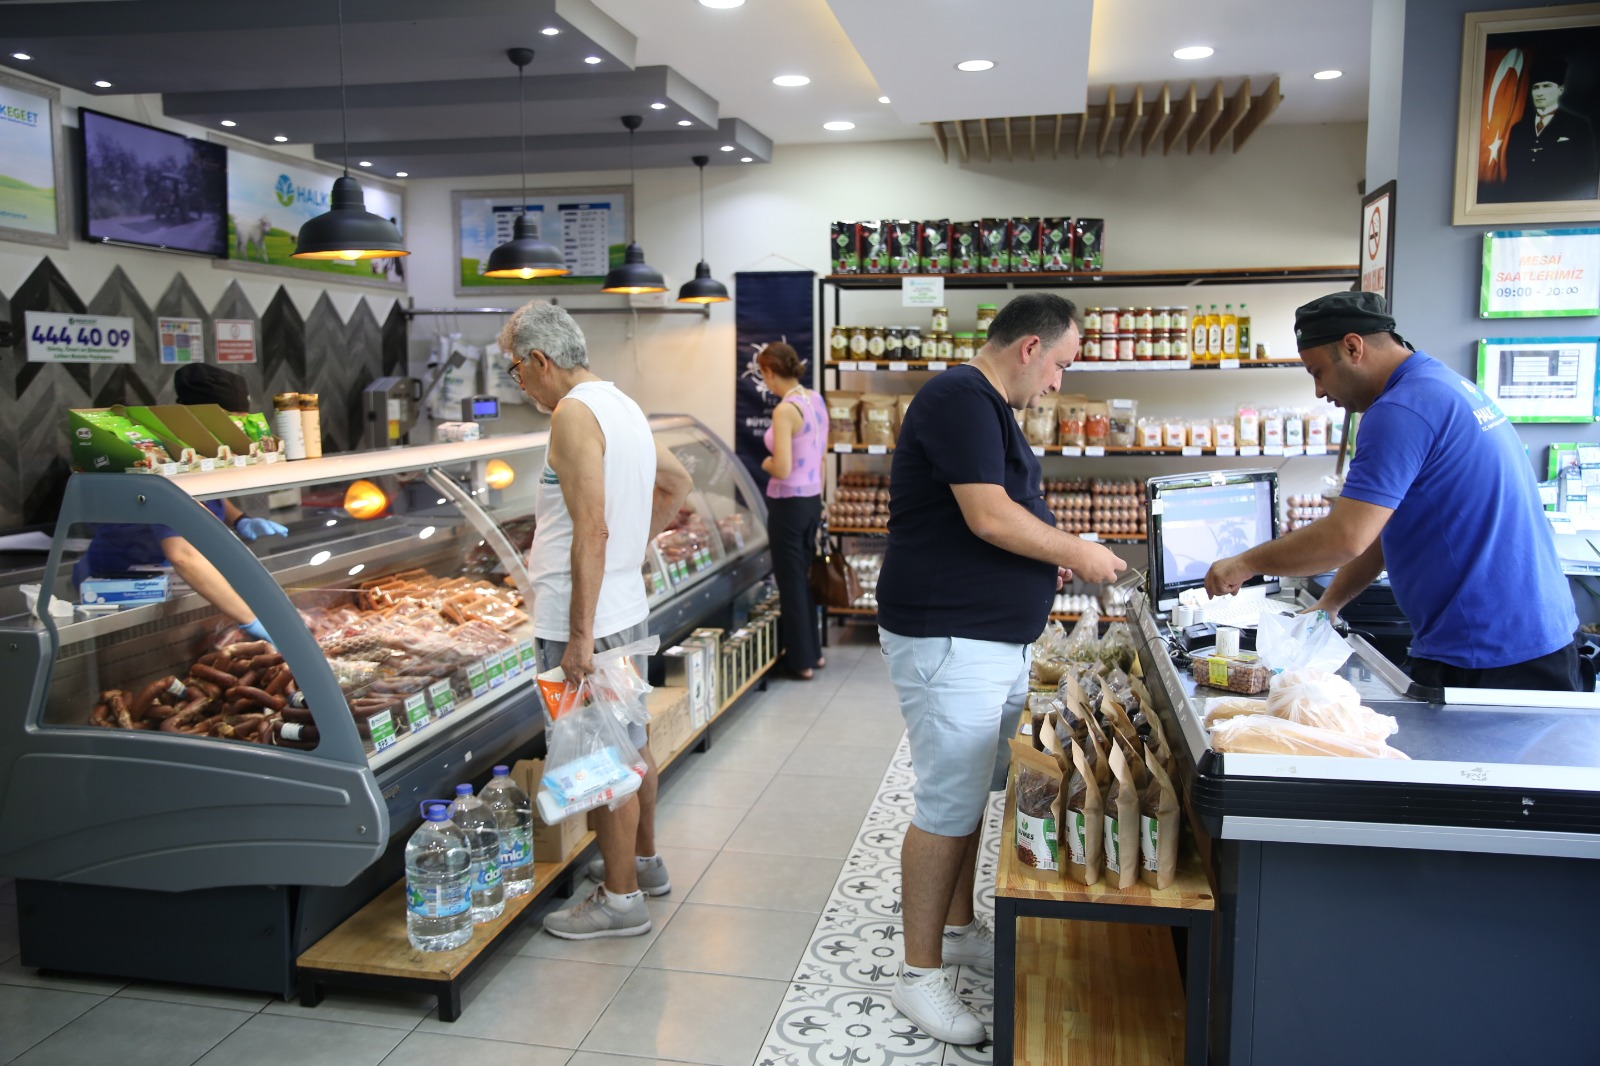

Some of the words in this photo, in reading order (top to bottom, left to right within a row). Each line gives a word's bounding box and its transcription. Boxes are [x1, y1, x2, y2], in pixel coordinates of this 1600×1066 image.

[297, 186, 332, 206] HALK
[1519, 252, 1562, 266] MESAİ
[1496, 267, 1584, 282] SAATLERİMİZ
[1496, 287, 1532, 298] 09:00
[1546, 286, 1579, 297] 20:00
[32, 325, 72, 344] 444
[77, 327, 102, 346] 40
[107, 328, 131, 347] 09
